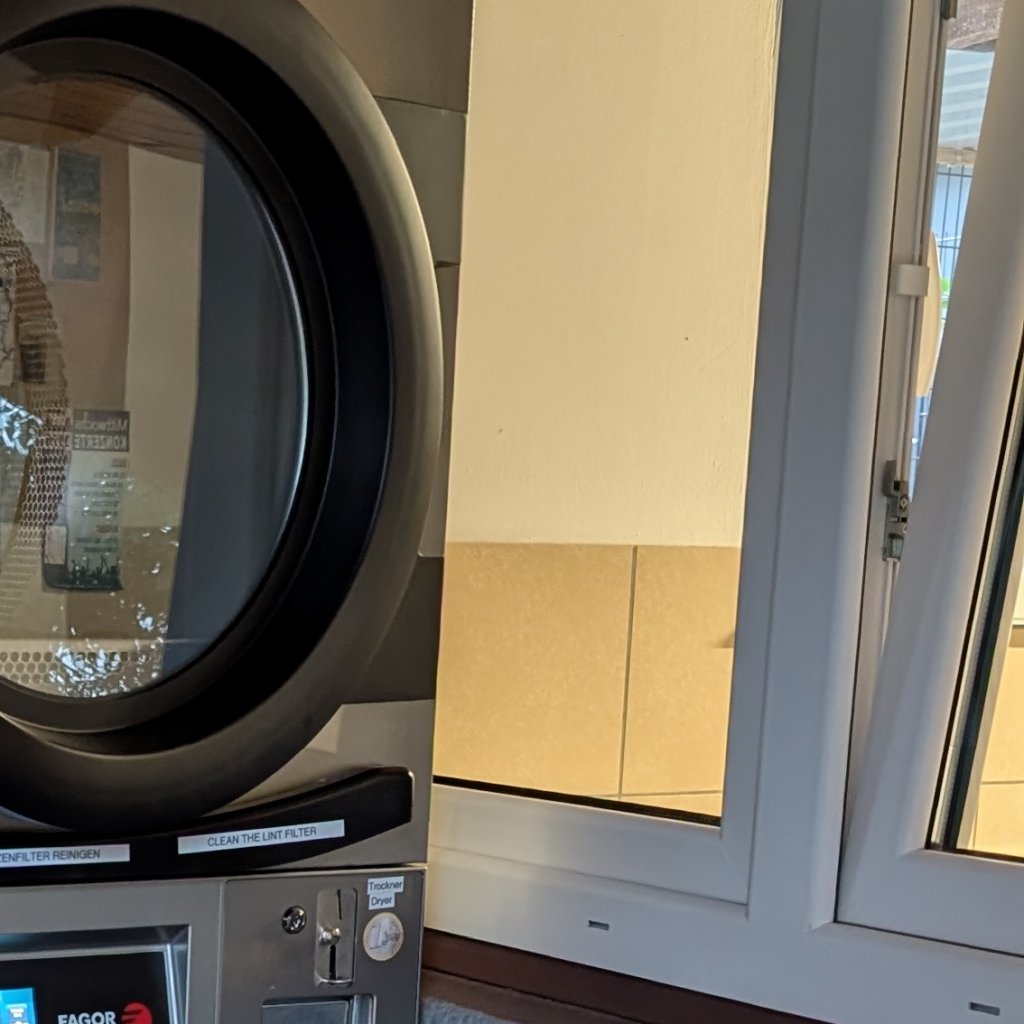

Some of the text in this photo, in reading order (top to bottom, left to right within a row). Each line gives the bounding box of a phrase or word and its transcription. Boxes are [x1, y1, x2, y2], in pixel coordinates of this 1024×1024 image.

[207, 826, 317, 847] CLEAN THE LINT FILTER
[52, 849, 101, 861] REINIGEN
[368, 880, 403, 891] Trockner
[371, 895, 392, 906] Dryer
